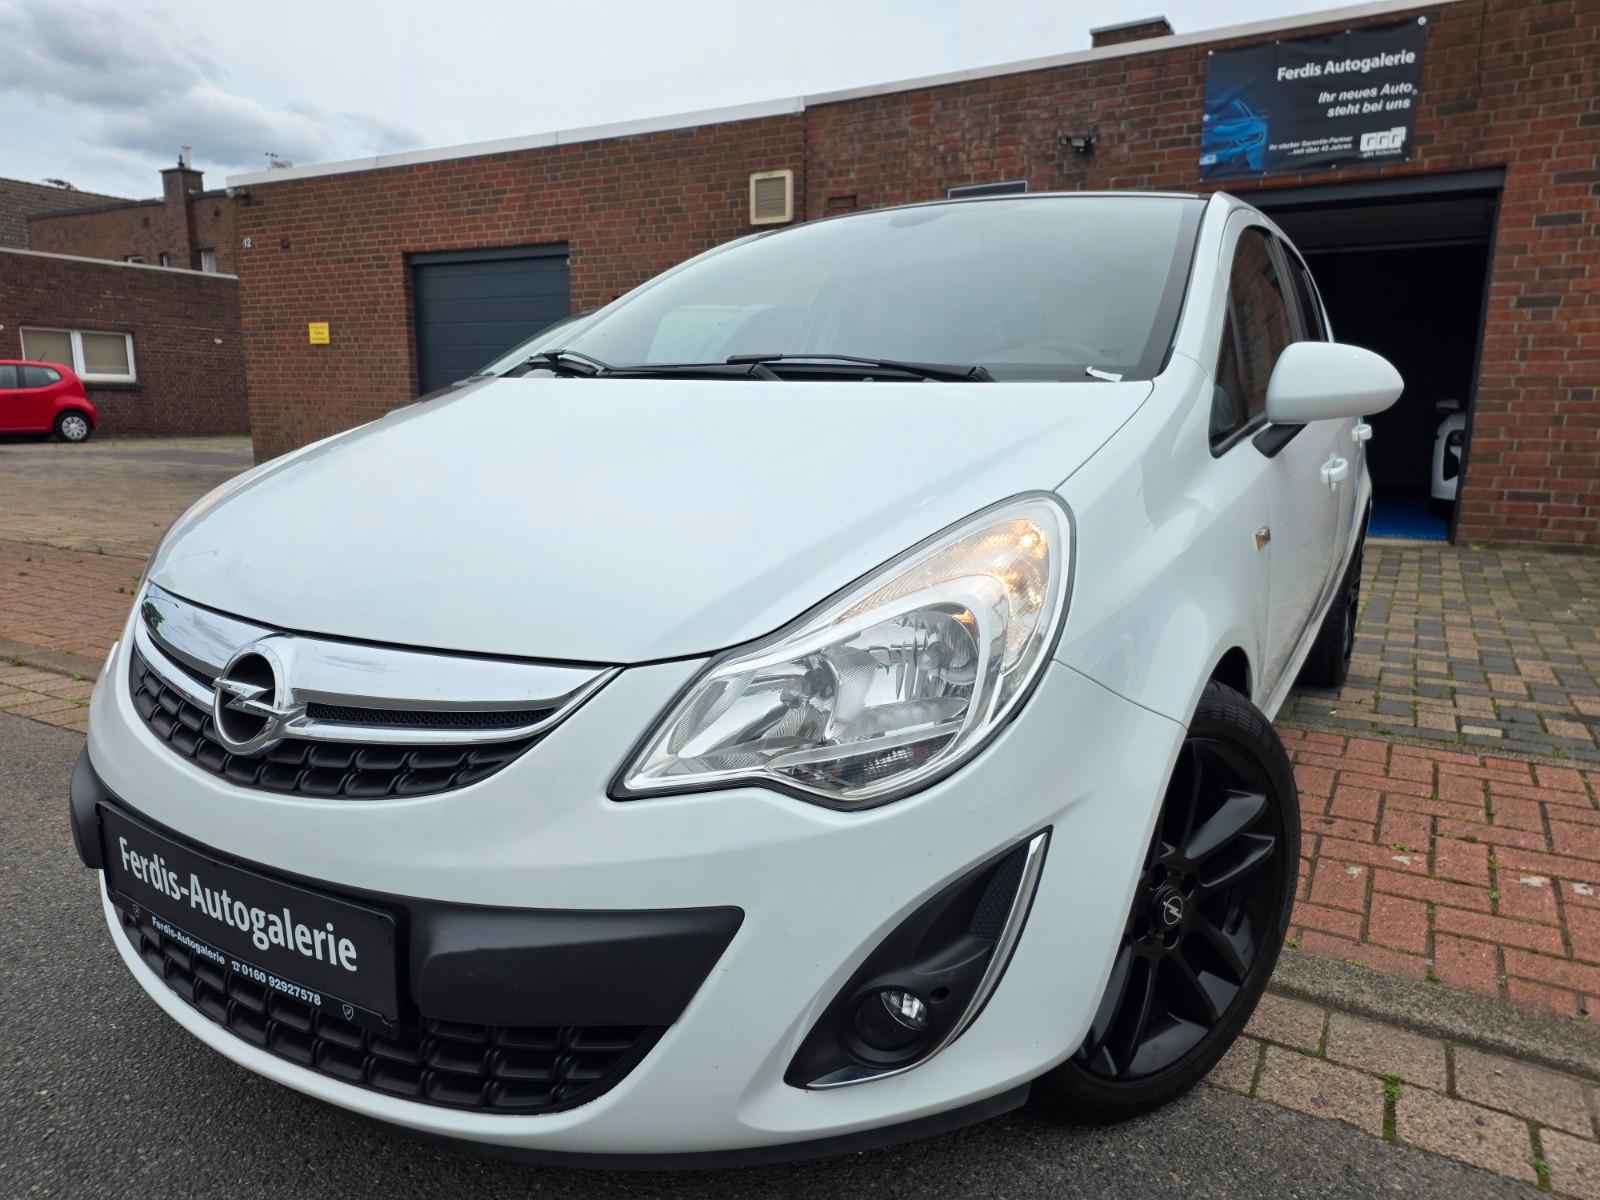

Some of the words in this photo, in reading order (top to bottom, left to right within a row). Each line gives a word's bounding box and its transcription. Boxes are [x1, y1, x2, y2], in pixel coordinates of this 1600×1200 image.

[1277, 62, 1321, 81] Ferdis
[1323, 49, 1416, 74] Autogalerie
[1318, 91, 1337, 104] Ihr
[1338, 87, 1378, 101] neues
[1327, 103, 1360, 118] steht
[1362, 99, 1384, 114] bei
[1386, 98, 1411, 111] uns
[243, 237, 252, 248] 12
[119, 836, 358, 972] Ferdis-Autogalerie
[152, 916, 225, 965] Ferdis-Autogalerie
[241, 964, 267, 984] 0160
[268, 975, 322, 1006] 92927578
